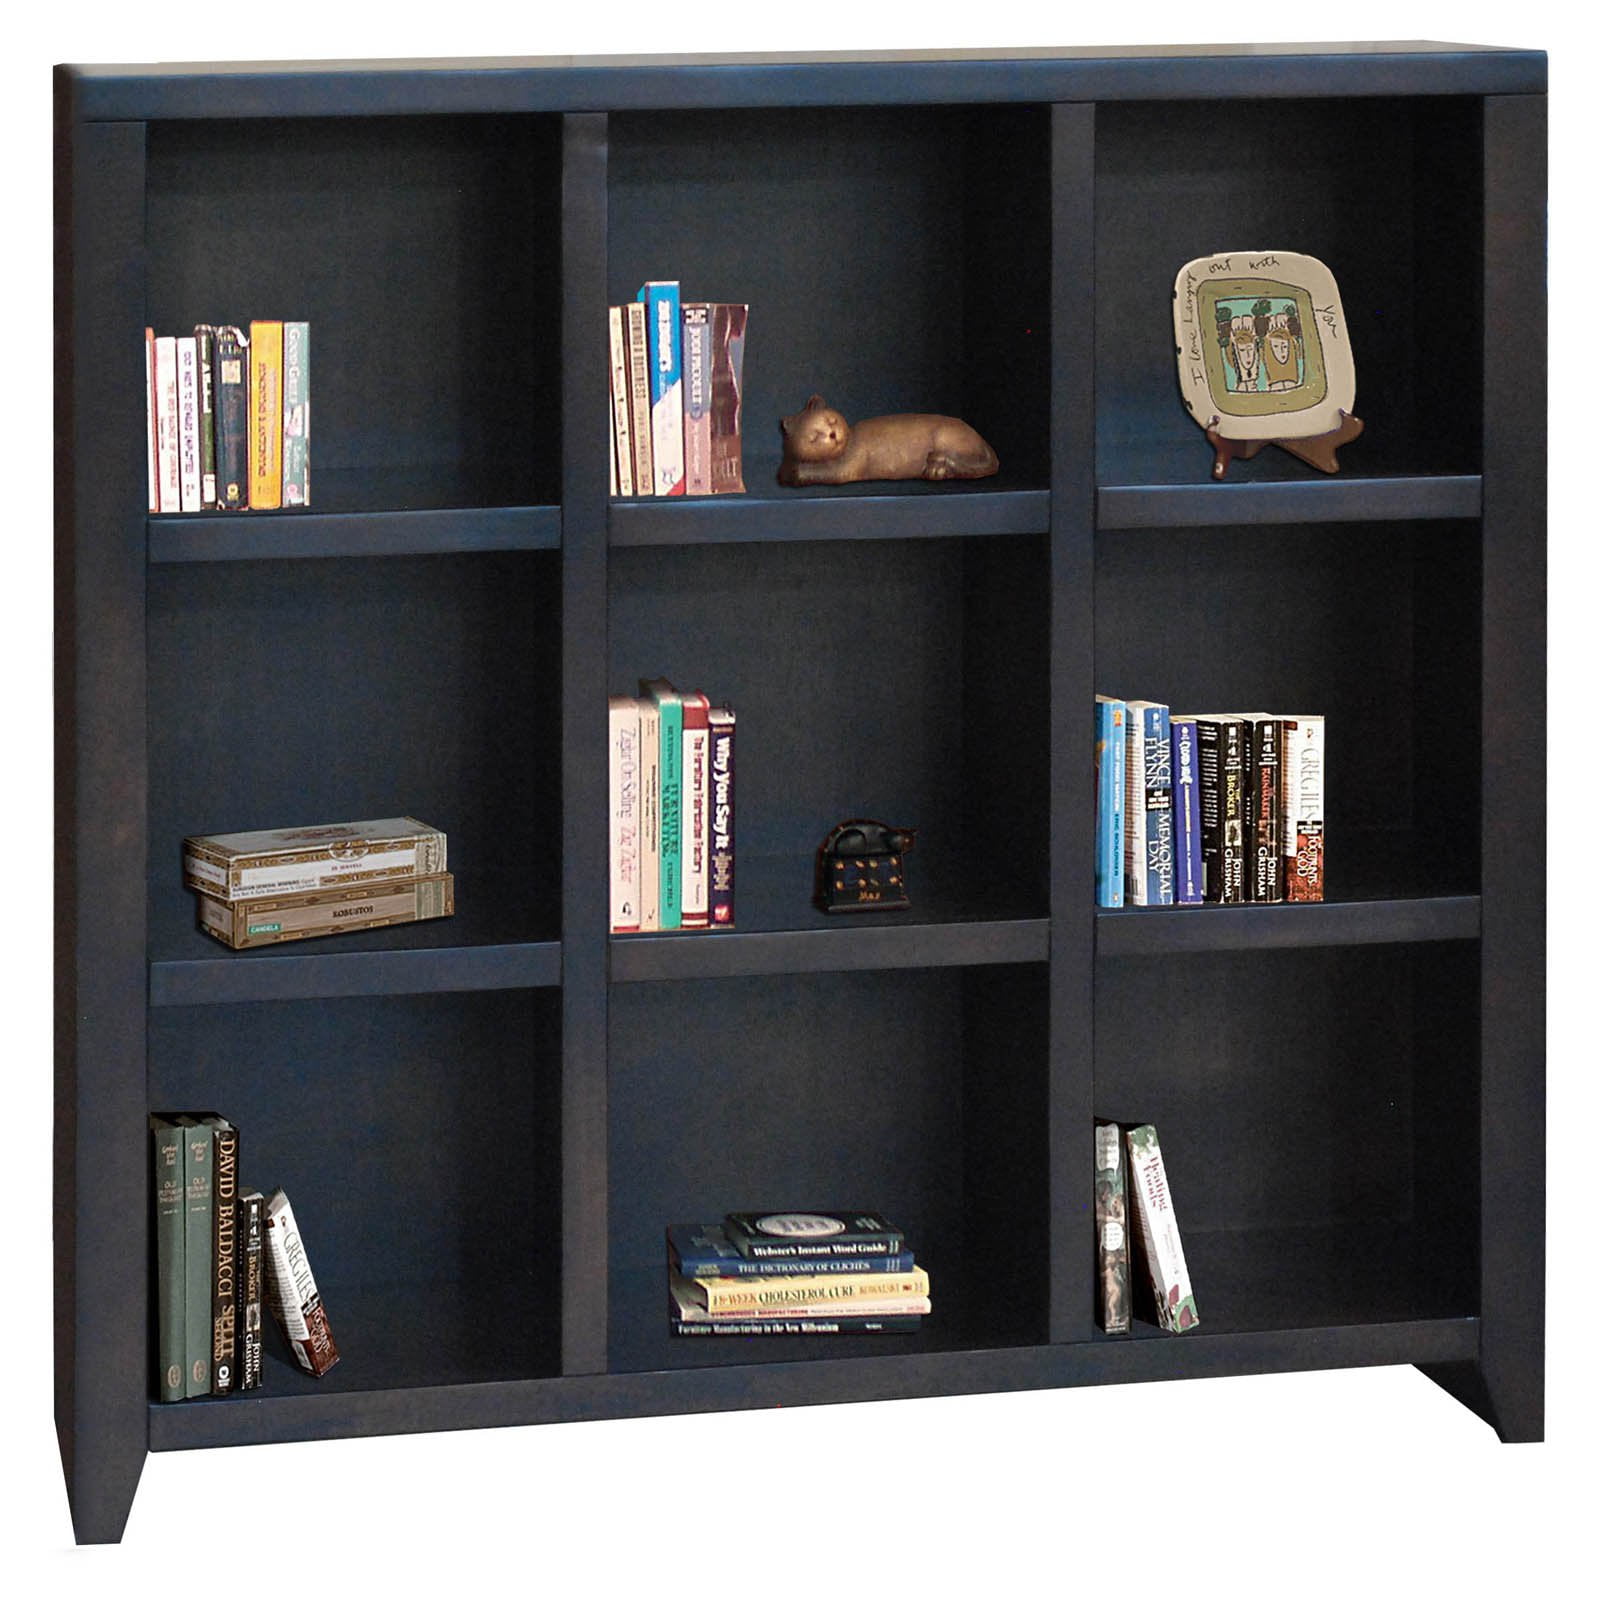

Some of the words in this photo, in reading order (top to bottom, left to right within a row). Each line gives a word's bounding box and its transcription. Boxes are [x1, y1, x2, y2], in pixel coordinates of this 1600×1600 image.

[1209, 258, 1232, 274] out
[1248, 255, 1281, 271] with
[713, 736, 730, 772] Why
[1145, 737, 1158, 788] FLYNN
[1158, 738, 1171, 785] VINCE
[1300, 748, 1320, 791] GREG
[713, 772, 730, 805] You
[1227, 774, 1237, 817] BROKER
[1261, 767, 1271, 819] RAINMAKER
[1300, 792, 1320, 820] ILES
[713, 805, 730, 836] Say
[715, 836, 730, 850] It
[1148, 840, 1159, 874] DAY
[1157, 812, 1171, 895] MEMORIAL
[1224, 848, 1234, 897] GRISHAM
[1232, 858, 1243, 887] JOHN
[1258, 846, 1268, 896] GRISHAM
[1267, 856, 1278, 886] JOHN
[1297, 850, 1309, 877] GOD
[219, 1140, 235, 1198] DAVID
[218, 1204, 233, 1297] BALDACCI
[283, 1232, 307, 1277] GREG
[296, 1272, 318, 1302] ILES
[738, 1263, 758, 1273] THE
[760, 1262, 814, 1273] DICTIONARY
[816, 1263, 828, 1271] OF
[753, 1246, 796, 1257] Webster's
[797, 1245, 831, 1255] Instant
[832, 1244, 857, 1254] Word
[858, 1242, 887, 1253] Guide
[248, 1255, 257, 1301] BROKER
[759, 1288, 826, 1303] CHOLESTEROL
[829, 1286, 853, 1297] CURE
[214, 1316, 223, 1362] SECOND
[222, 1304, 235, 1358] SPLIT
[772, 1323, 784, 1333] the
[245, 1333, 255, 1385] GRISHAM
[252, 1342, 262, 1372] JOHN
